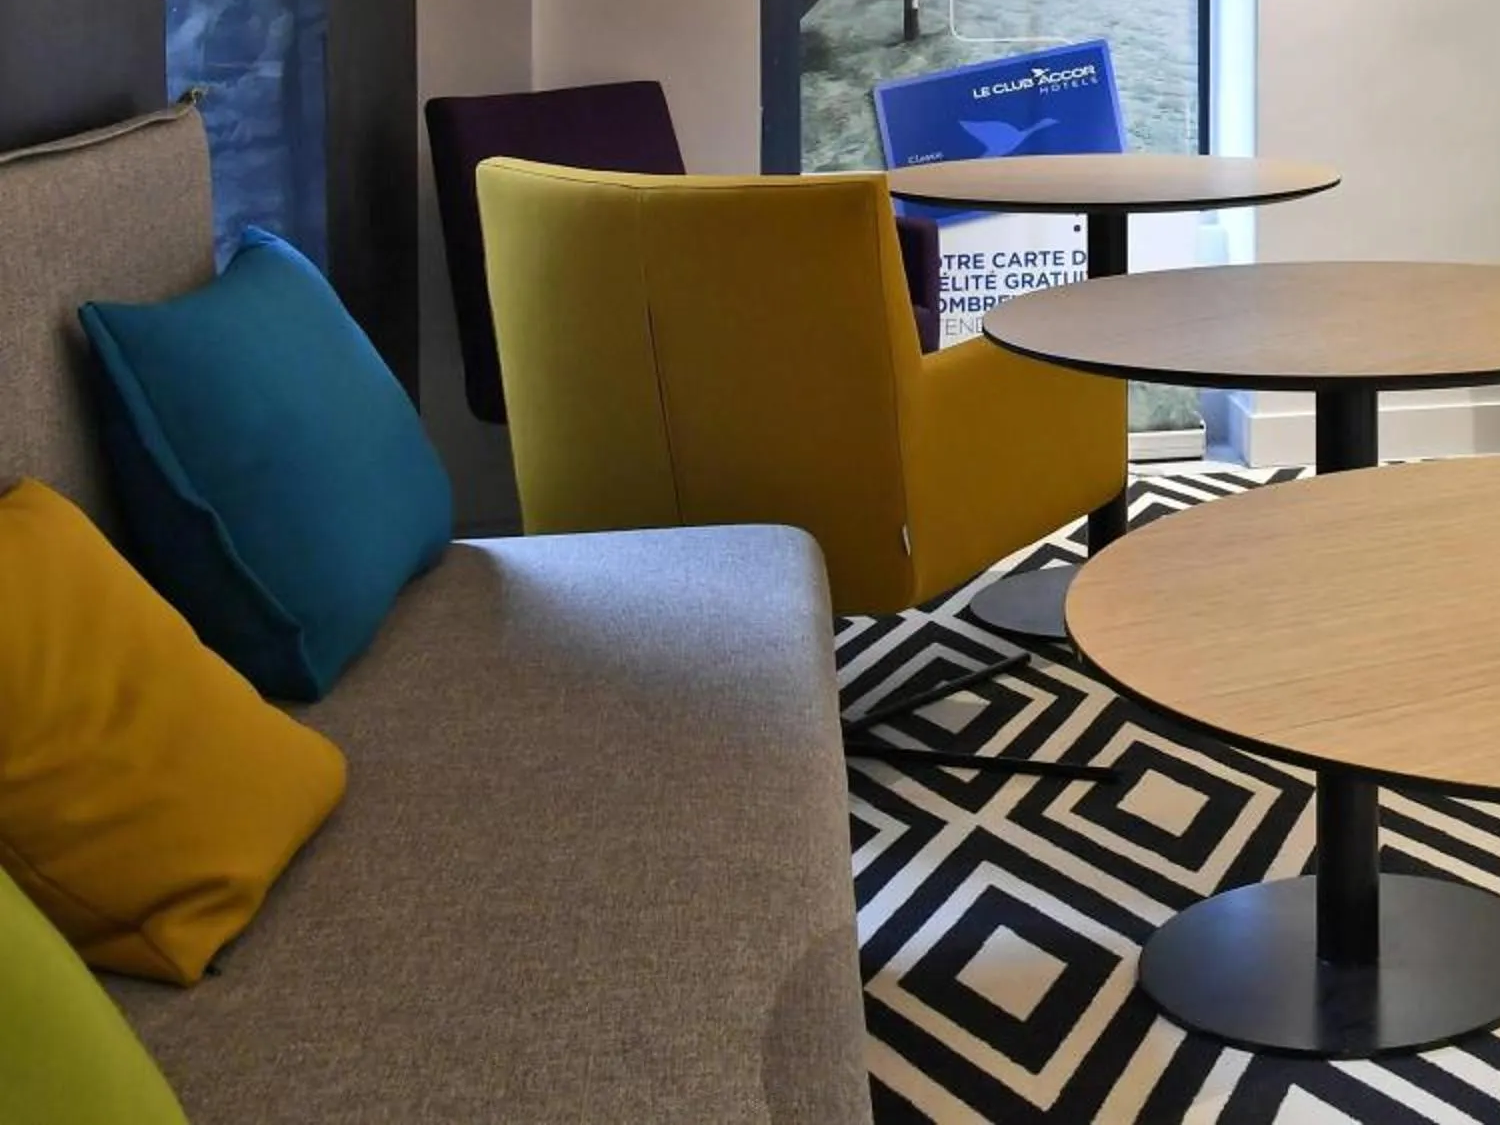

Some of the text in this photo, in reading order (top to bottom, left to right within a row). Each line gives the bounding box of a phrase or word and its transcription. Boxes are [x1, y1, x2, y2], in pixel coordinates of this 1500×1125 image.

[973, 64, 1096, 100] LE CLUB ACCOR
[939, 252, 985, 270] TRE
[992, 250, 1065, 268] CARTE
[1004, 271, 1088, 290] GRATUI
